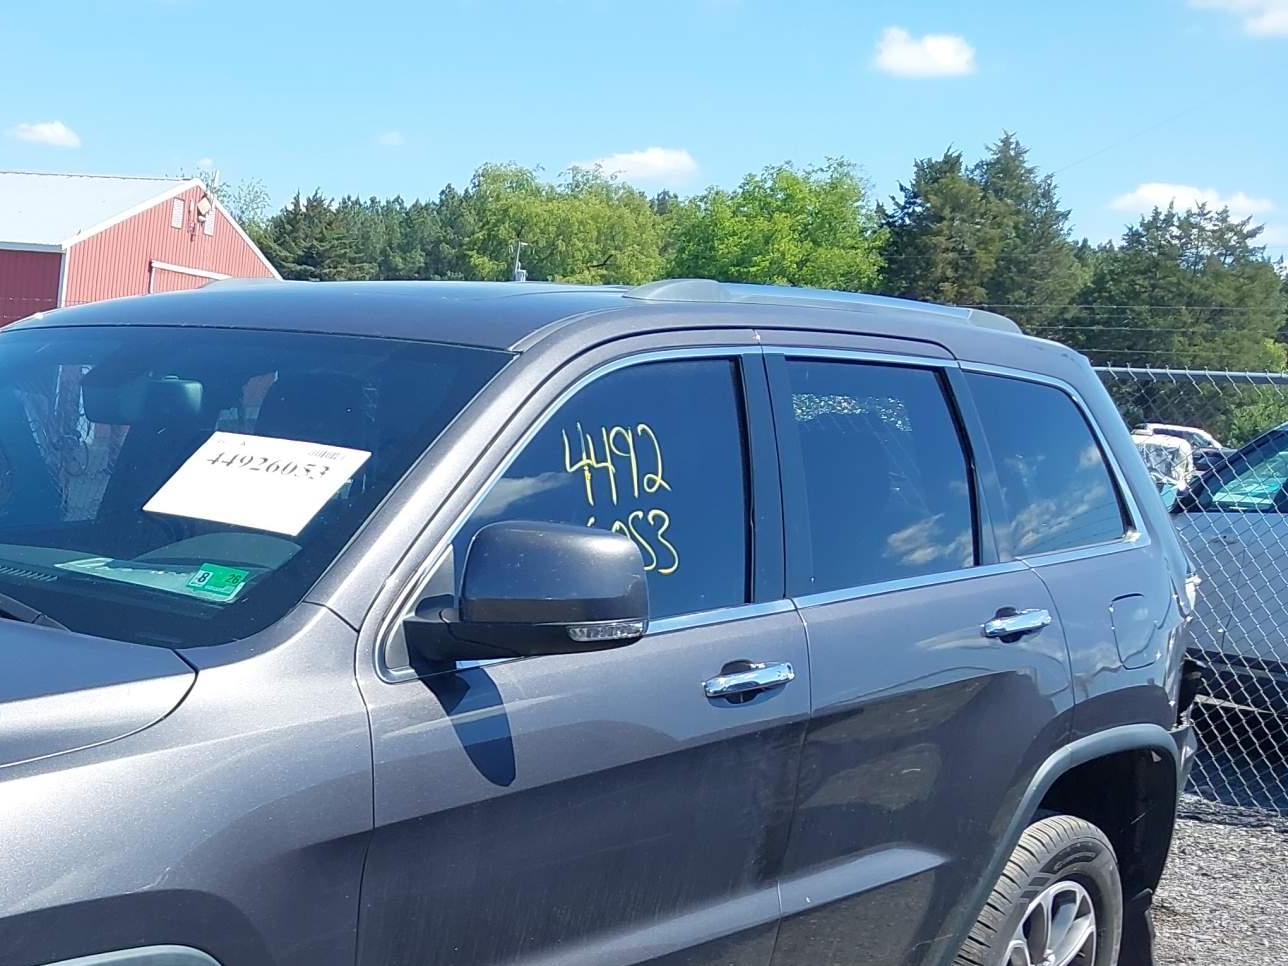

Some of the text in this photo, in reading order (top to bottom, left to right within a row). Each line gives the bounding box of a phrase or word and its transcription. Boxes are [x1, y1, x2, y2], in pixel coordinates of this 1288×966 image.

[206, 451, 331, 480] 44926053
[562, 422, 672, 506] 4492
[197, 572, 210, 583] 8
